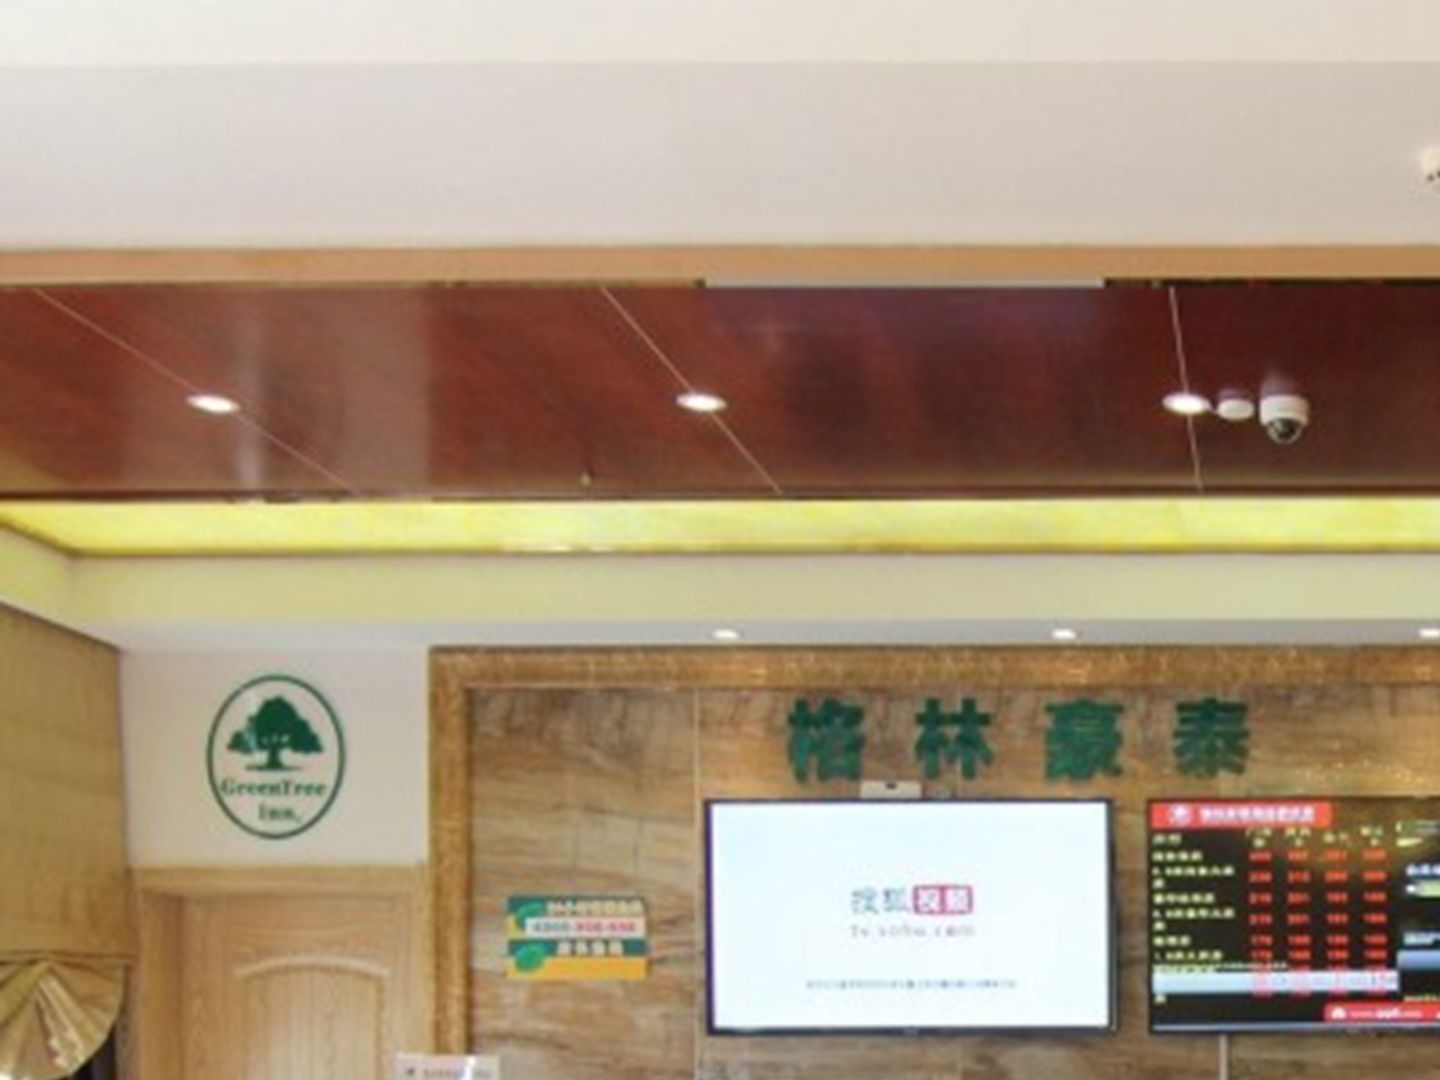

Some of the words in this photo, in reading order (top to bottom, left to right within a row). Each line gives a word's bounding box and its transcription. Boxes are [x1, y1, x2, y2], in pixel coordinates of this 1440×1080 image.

[788, 698, 1250, 782] 格林豪泰
[221, 779, 326, 797] GreenTree
